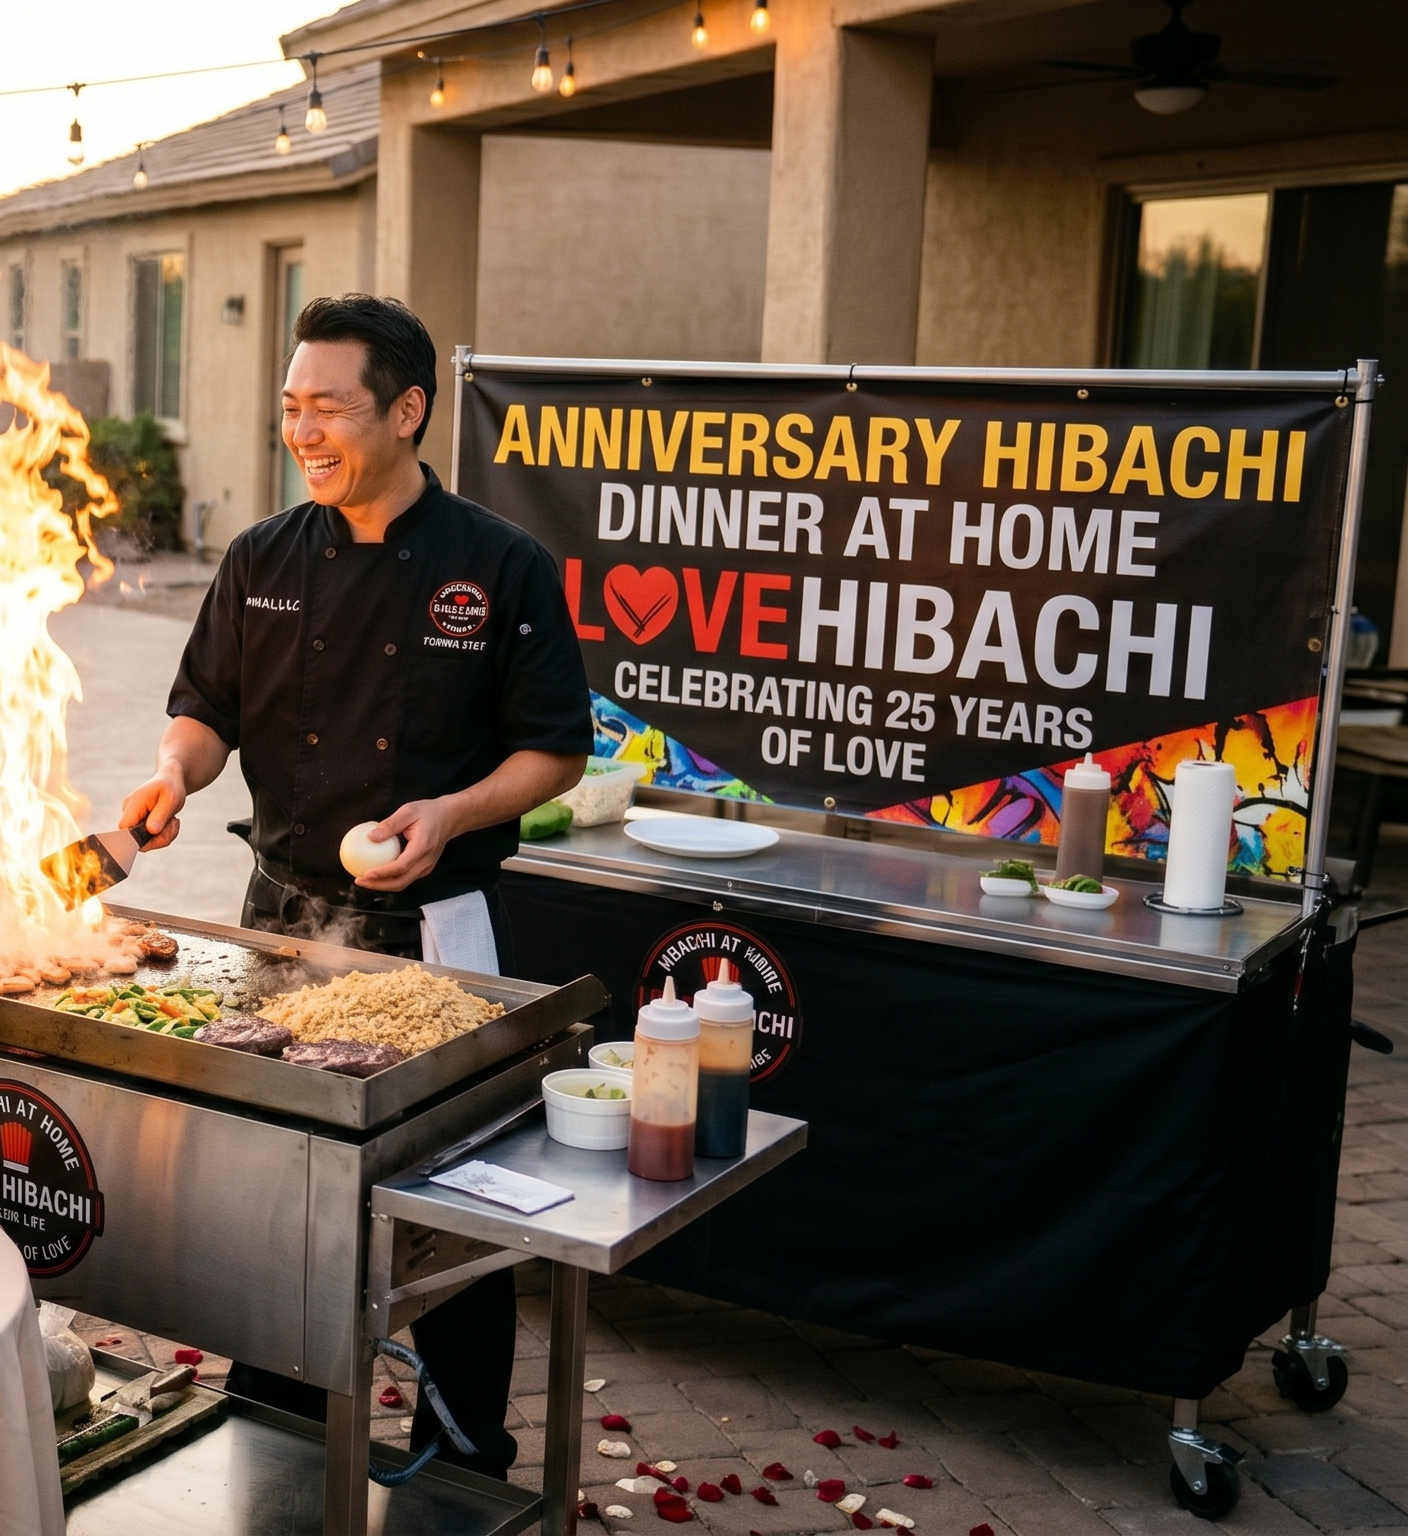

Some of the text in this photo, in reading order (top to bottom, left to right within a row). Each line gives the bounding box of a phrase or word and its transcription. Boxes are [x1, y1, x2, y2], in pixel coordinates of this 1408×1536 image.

[493, 404, 1307, 503] ANNIVERSARY HIBACHI
[598, 482, 1161, 578] DINNER AT HOME
[614, 661, 1094, 749] CELEBRATING 25 YEARS
[761, 725, 927, 783] OF LOVE
[720, 934, 741, 953] AT
[15, 1099, 38, 1120] AT
[39, 1114, 80, 1171] HOME
[2, 1173, 91, 1225] HIBACHI
[23, 1234, 72, 1261] OF LOVE
